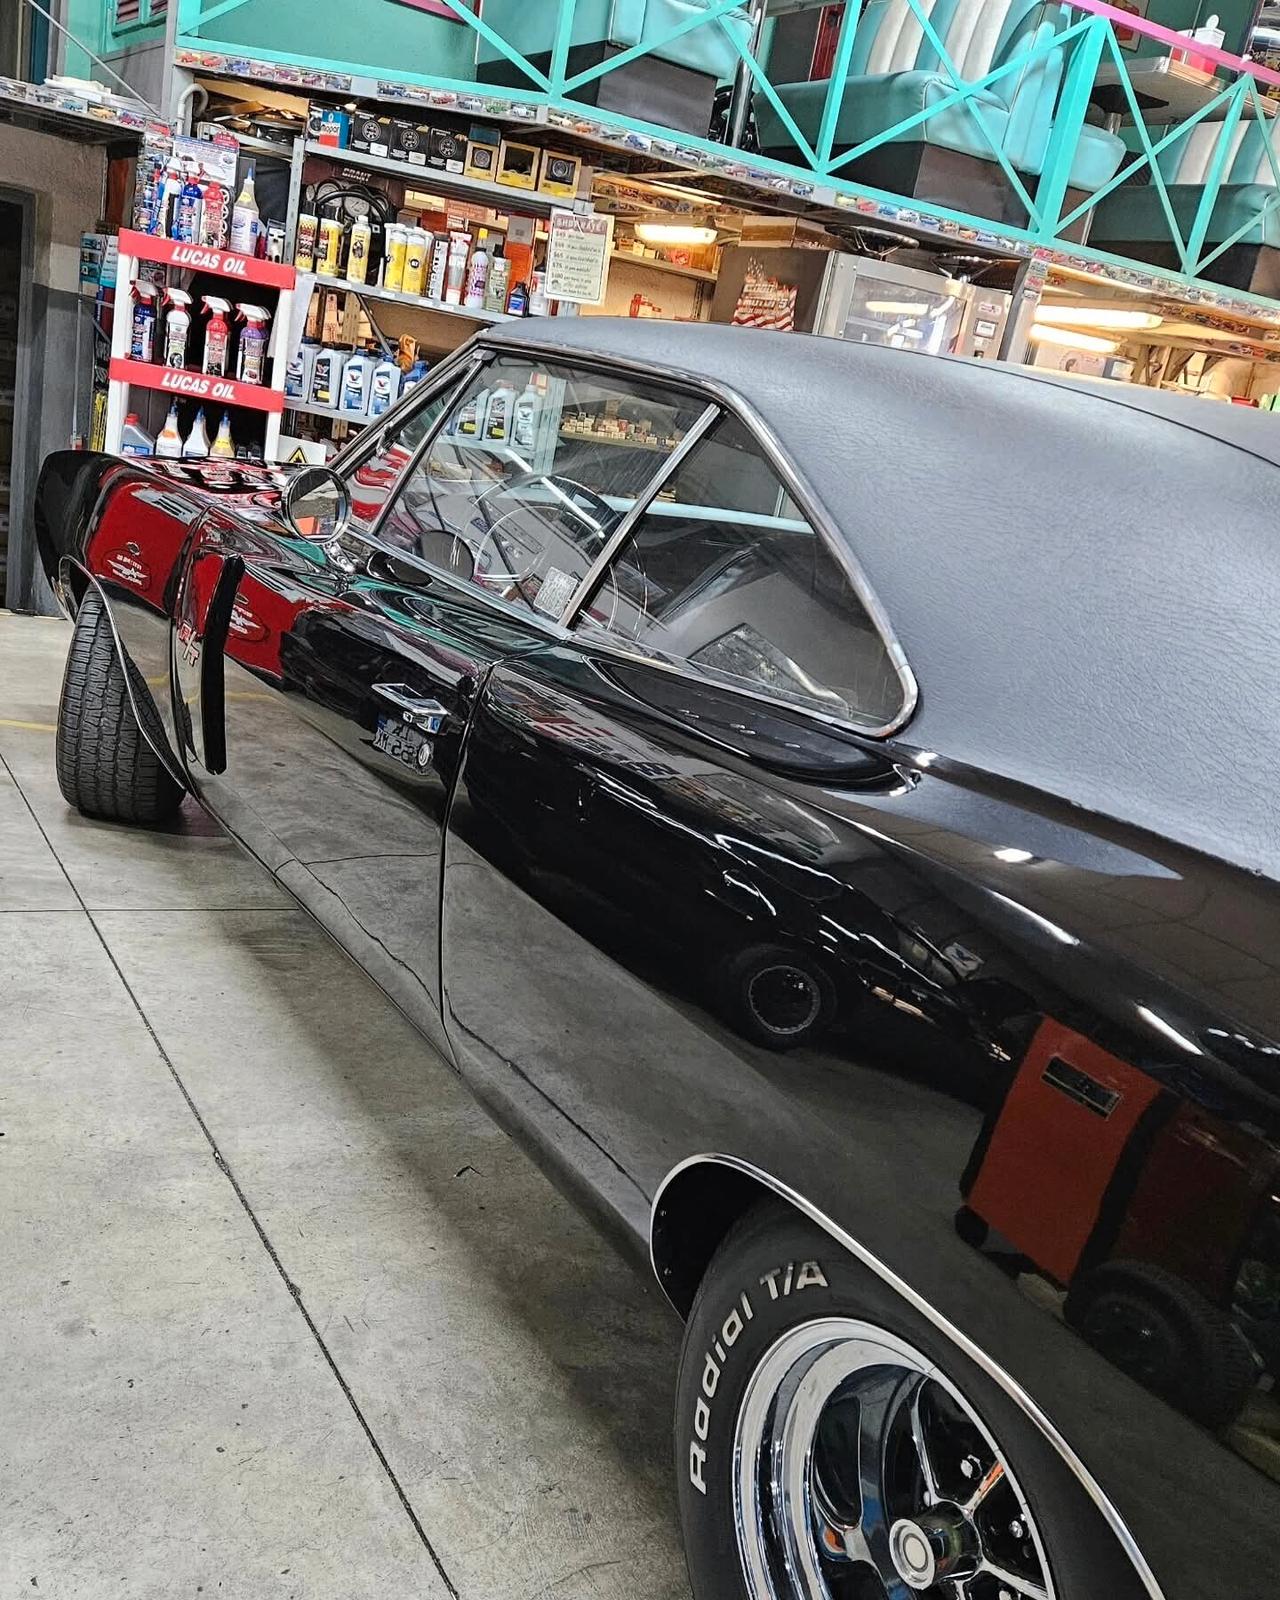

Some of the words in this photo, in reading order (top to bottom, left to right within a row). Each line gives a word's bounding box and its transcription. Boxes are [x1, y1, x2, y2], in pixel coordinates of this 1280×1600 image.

[171, 246, 221, 269] LUCAS
[222, 257, 247, 275] OIL
[161, 372, 210, 394] LUCAS
[212, 382, 235, 400] OIL
[179, 622, 200, 667] R/T
[689, 1291, 754, 1495] Radial
[759, 1261, 829, 1300] T/A
